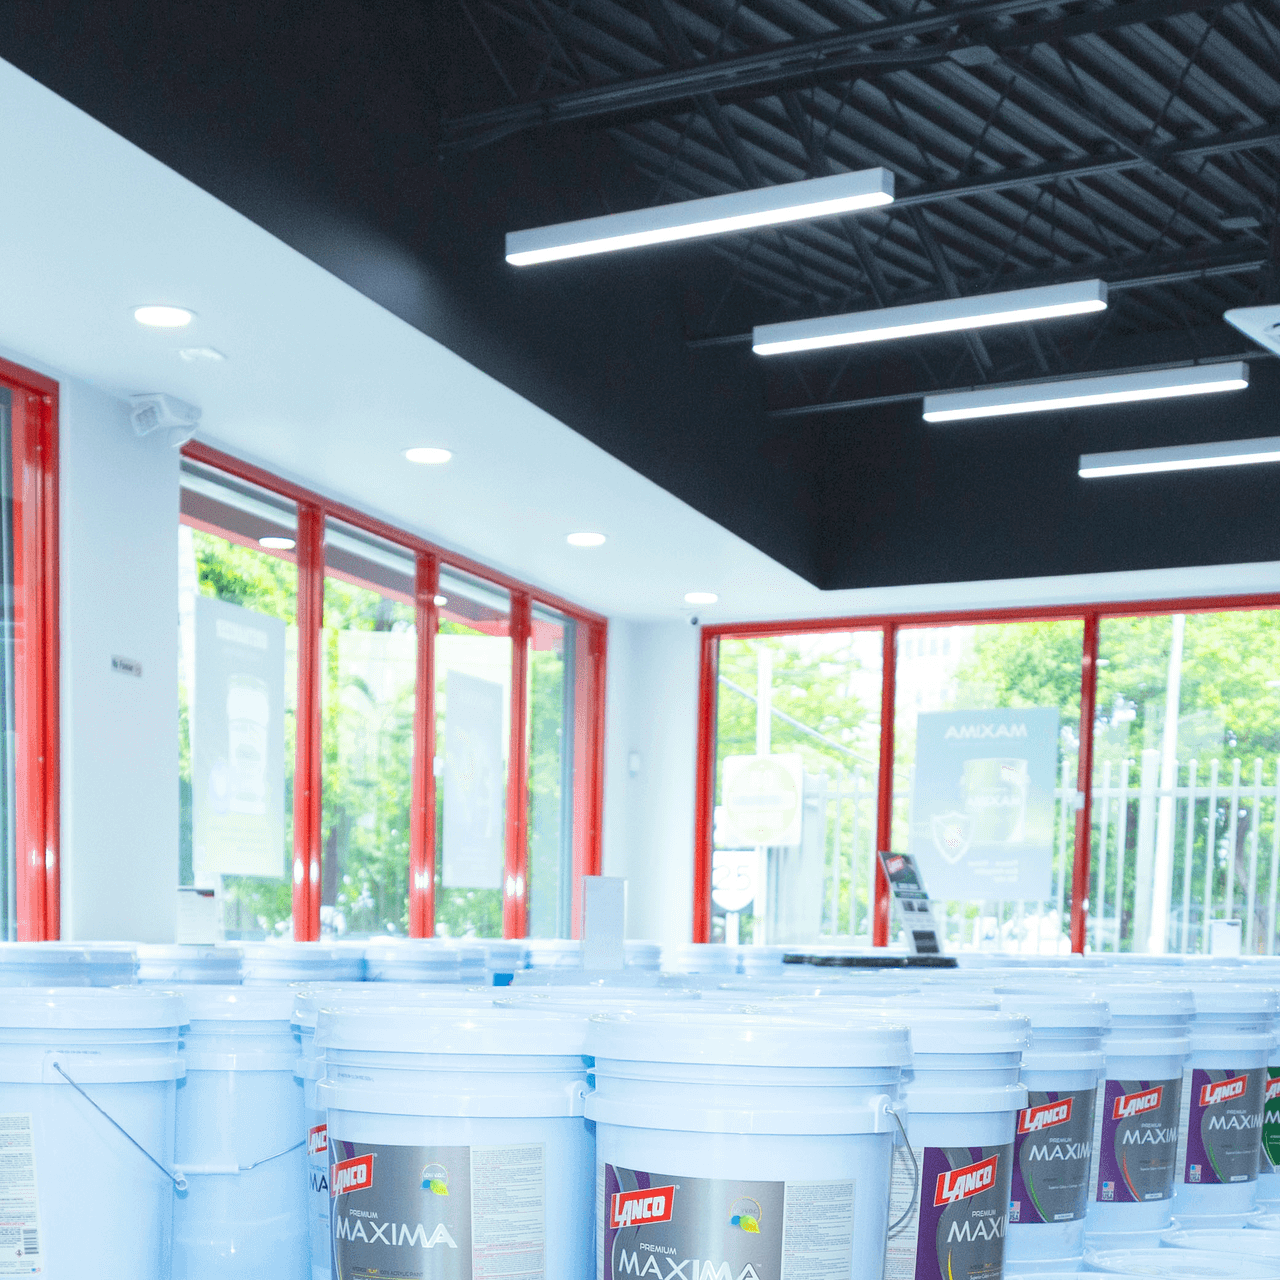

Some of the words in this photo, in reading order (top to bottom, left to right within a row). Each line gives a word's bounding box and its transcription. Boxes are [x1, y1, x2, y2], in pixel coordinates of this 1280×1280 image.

[1120, 1091, 1158, 1116] LANCO
[1205, 1080, 1243, 1104] LANCO
[1024, 1105, 1067, 1130] LANCO
[1029, 1141, 1091, 1161] MAXIM
[331, 1163, 367, 1194] LANCO
[943, 1166, 992, 1202] LANCO
[350, 1209, 378, 1218] PREMIUM
[615, 1194, 665, 1227] LANCO
[972, 1210, 996, 1218] PREMIUM
[336, 1215, 458, 1248] MAXIMA
[640, 1243, 677, 1255] PREMIUM
